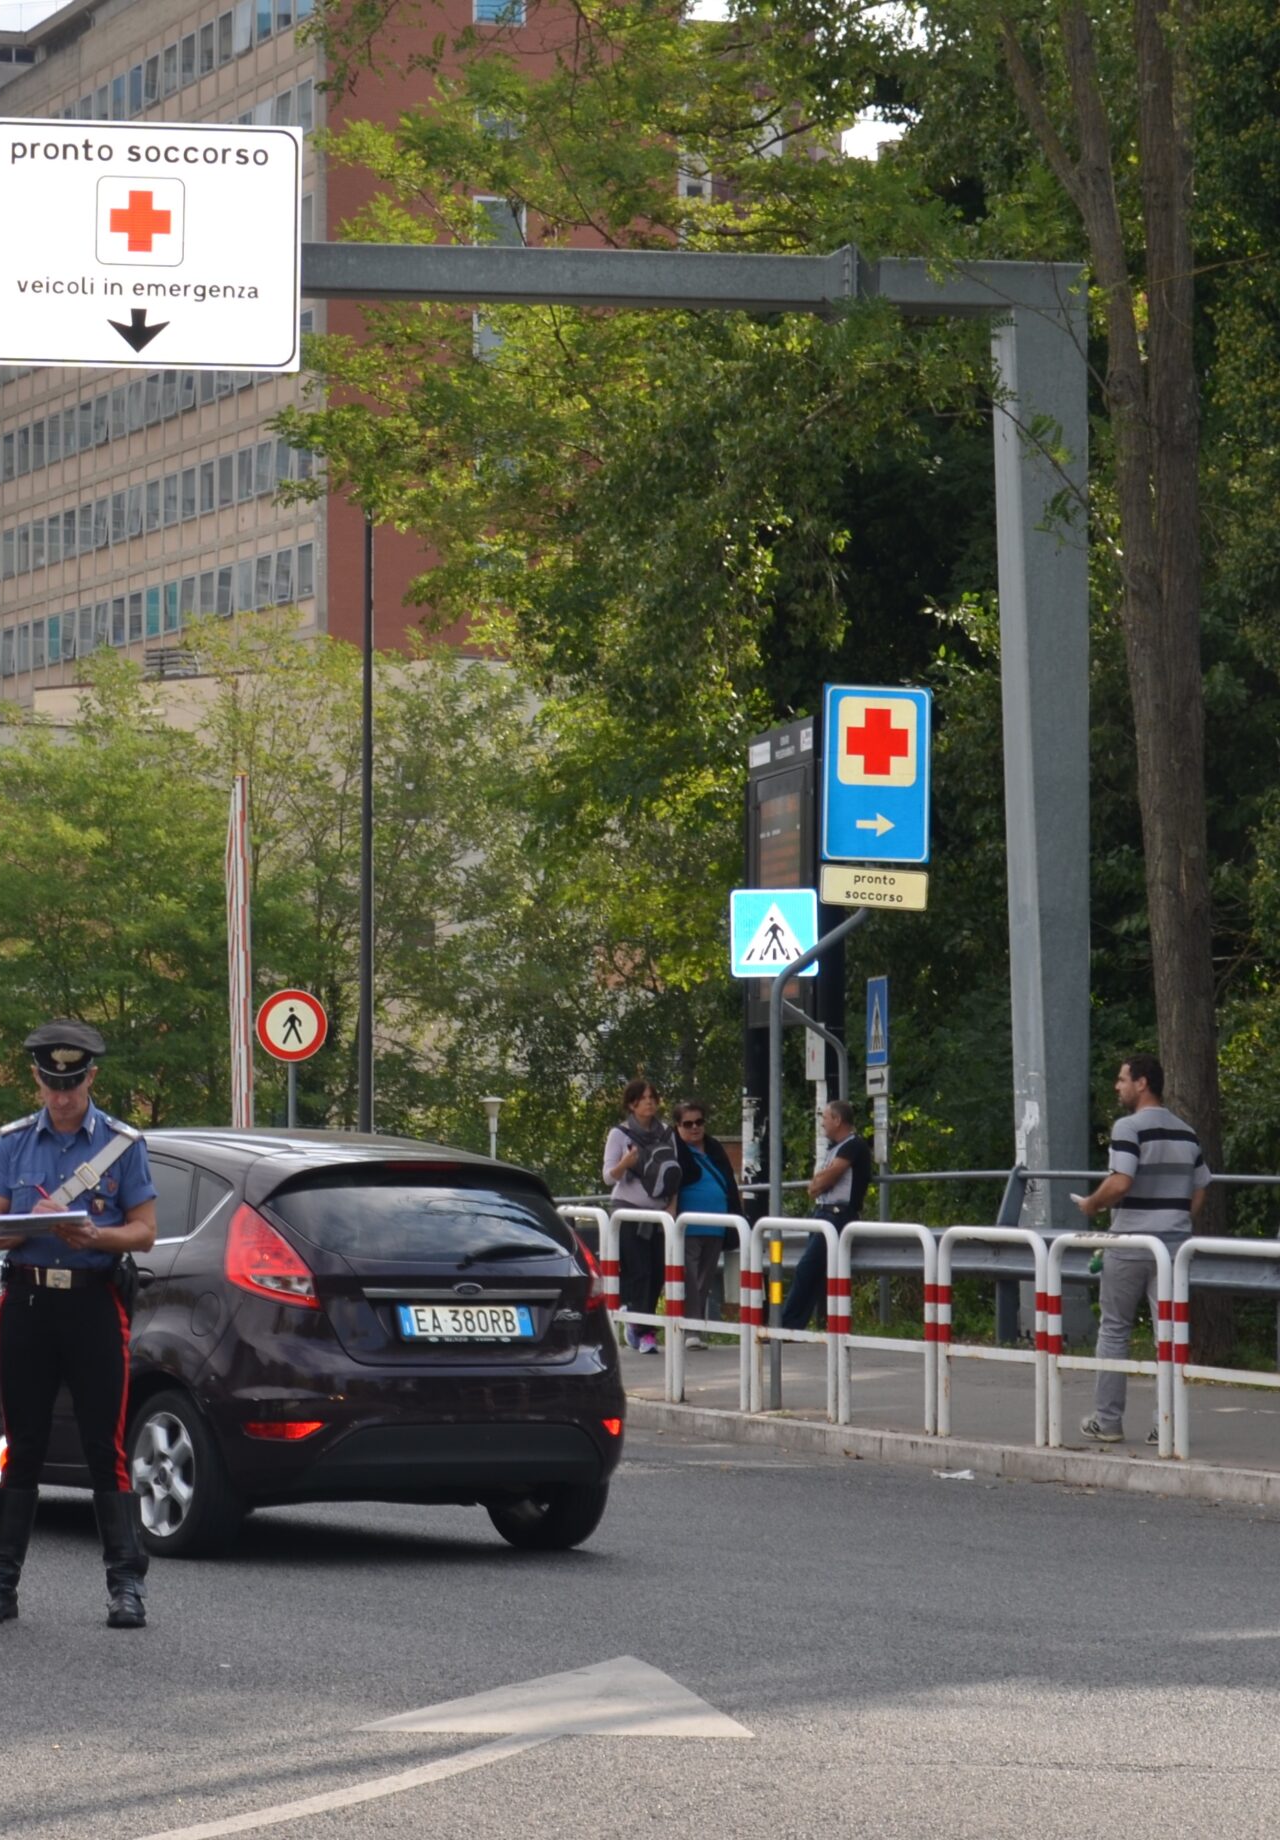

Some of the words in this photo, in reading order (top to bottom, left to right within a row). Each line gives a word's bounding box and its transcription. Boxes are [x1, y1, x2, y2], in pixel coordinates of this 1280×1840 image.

[11, 138, 114, 165] pronto
[127, 144, 269, 166] soccorso
[16, 276, 95, 296] veicoli
[104, 278, 123, 296] in
[132, 282, 260, 302] emergenza
[853, 874, 896, 886] pronto
[845, 890, 903, 903] soccorso
[414, 1309, 443, 1333] EA
